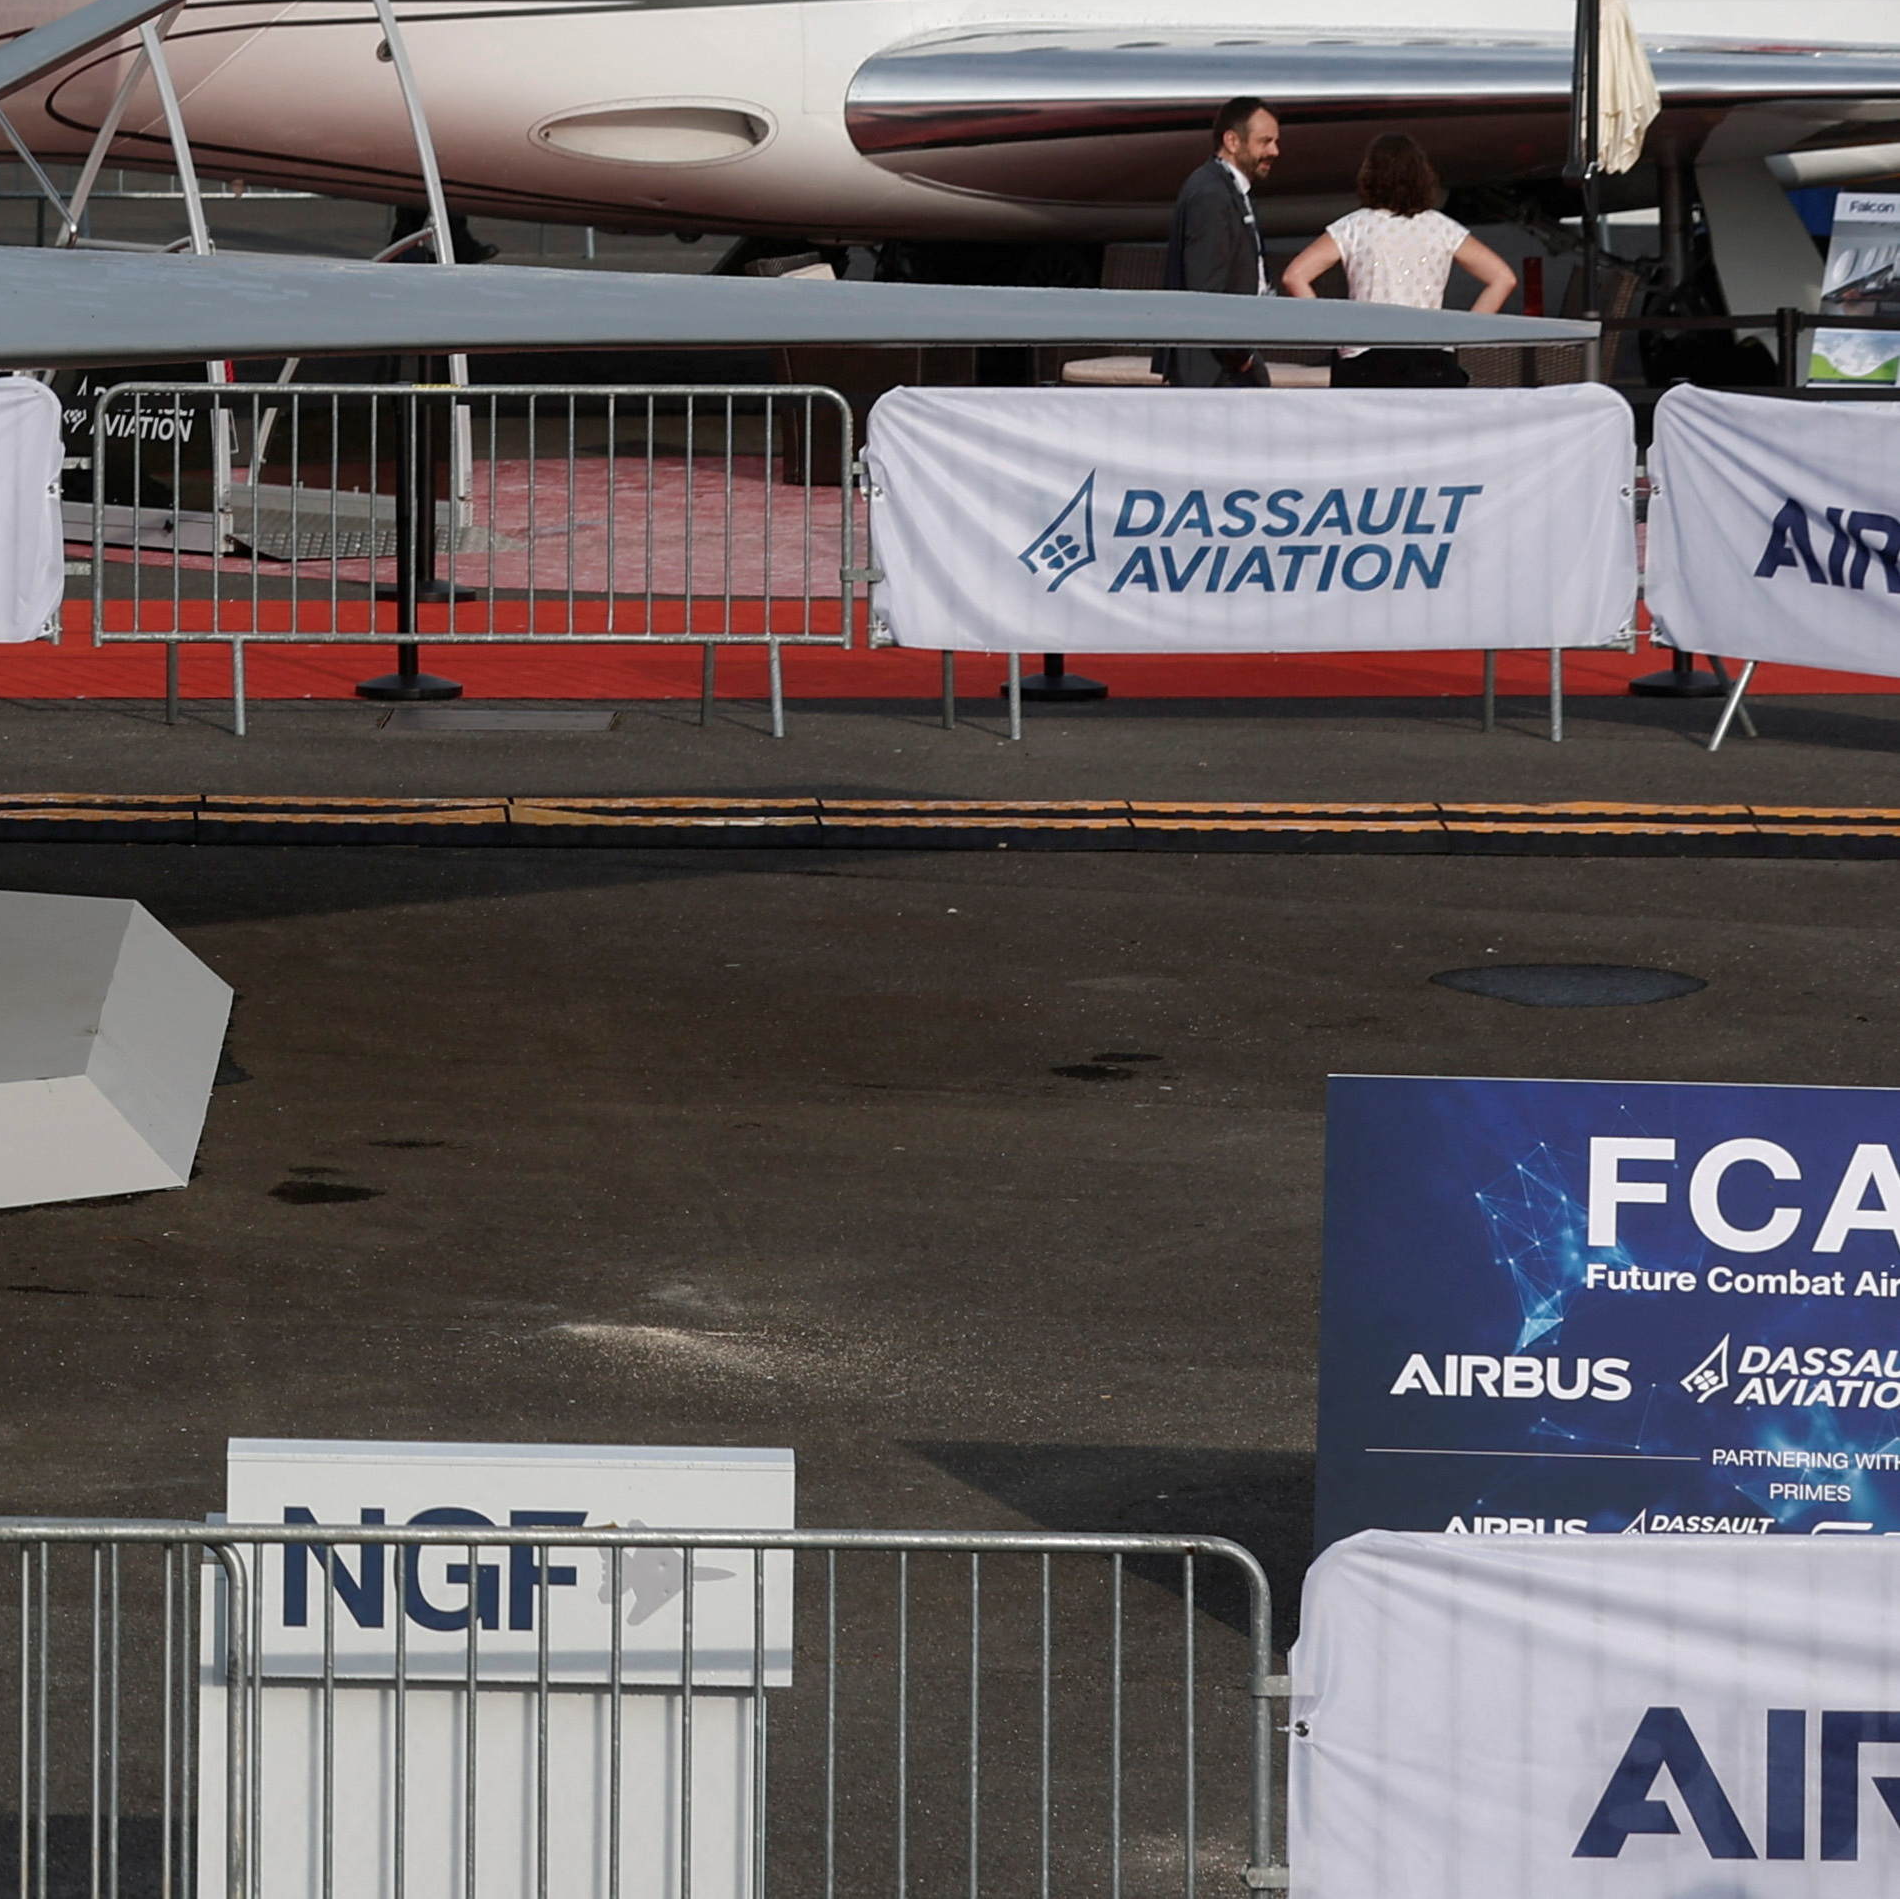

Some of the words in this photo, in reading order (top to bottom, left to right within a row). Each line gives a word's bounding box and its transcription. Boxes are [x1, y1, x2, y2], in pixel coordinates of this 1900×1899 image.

[1850, 200, 1896, 213] Falcon
[1113, 484, 1484, 539] DASSAULT
[1108, 542, 1451, 594] AVIATION
[1753, 497, 1900, 594] AIR
[1587, 1136, 1900, 1253] FCA
[1586, 1263, 1697, 1292] Future
[1707, 1266, 1846, 1297] Combat
[1853, 1270, 1900, 1298] Air
[1389, 1353, 1632, 1402] AIRBUS
[1733, 1377, 1900, 1410] AVIATIO
[1713, 1448, 1849, 1470] PARTNERING
[1770, 1482, 1852, 1503] PRIMES
[1650, 1514, 1774, 1534] DASSAULT
[283, 1505, 588, 1631] NGF
[1571, 1706, 1900, 1861] AIR
